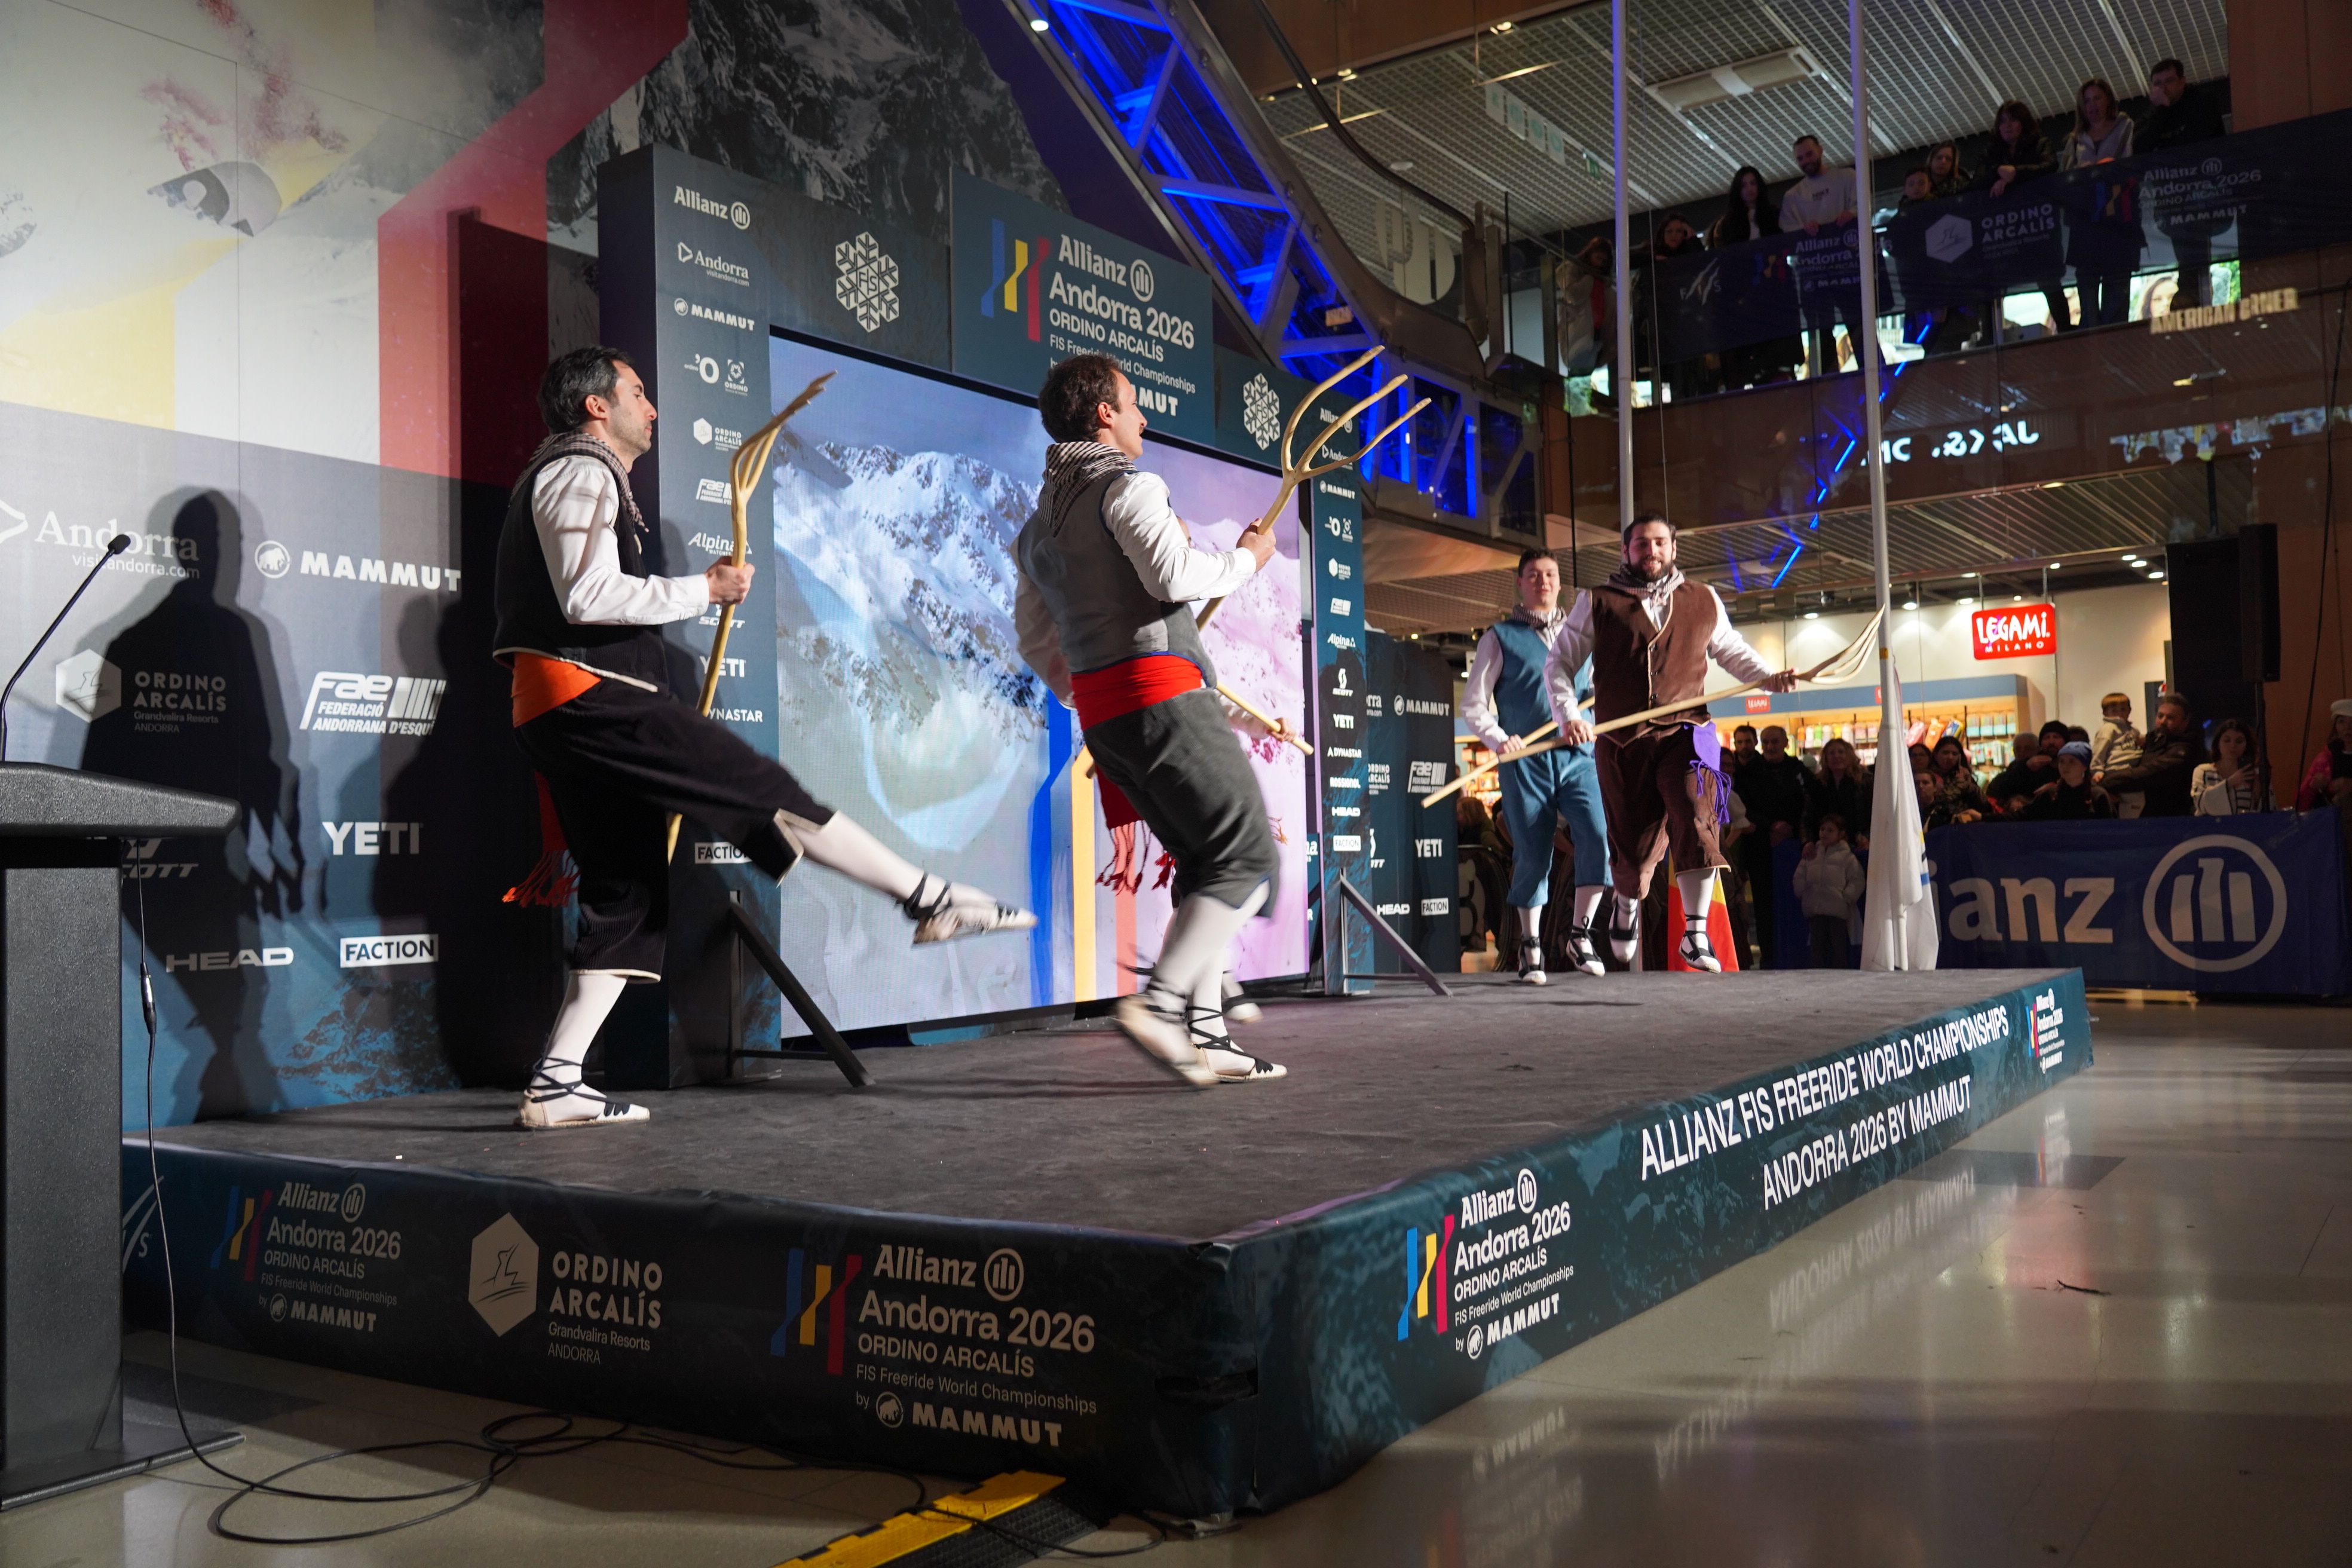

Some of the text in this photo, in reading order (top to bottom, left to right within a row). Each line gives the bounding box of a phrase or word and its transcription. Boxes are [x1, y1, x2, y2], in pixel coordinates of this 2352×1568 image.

[674, 186, 728, 220] Allianz
[1982, 204, 2053, 229] ORDINO
[694, 250, 749, 280] Andorra
[1058, 234, 1127, 287] Allianz
[691, 304, 755, 331] MAMMUT
[1049, 272, 1195, 350] Andorra 2026
[1049, 308, 1165, 362] ORDINO ARCALÍS
[1050, 334, 1065, 351] FIS
[1133, 362, 1196, 395] Championships
[1138, 386, 1178, 417] MUT
[715, 427, 742, 439] ORDINO
[1327, 483, 1355, 500] MAMMUT
[35, 511, 200, 561] Andorra
[72, 553, 200, 579] visiandorra.com
[301, 551, 461, 592] MAMMUT
[698, 616, 746, 629] SCTT
[1984, 641, 2044, 653] MILANO
[134, 670, 226, 693] ORDINO
[133, 691, 226, 712] ARCALÍS
[318, 701, 384, 718] FEDERACIÓ
[709, 708, 764, 723] YNASTAR
[1405, 699, 1450, 716] MAMMUT
[134, 722, 180, 733] ANDORRA
[312, 719, 386, 735] ANDORRANA
[1333, 714, 1354, 729] YETI
[1334, 747, 1362, 758] DYNASTAR
[1330, 777, 1361, 789] ROSSIGNOL
[1332, 807, 1361, 817] HEAD
[323, 822, 423, 856] YETI
[697, 845, 743, 859] FACTIO
[1335, 839, 1359, 848] FACTION
[1415, 838, 1443, 858] YETI
[1376, 904, 1410, 915] HEAD
[1423, 902, 1447, 913] FACTION
[166, 947, 295, 973] HEAD
[345, 939, 435, 961] FACTION
[1642, 1004, 2010, 1181] ALLIANZ FIS FREERIDE WORLD CHAMPIONSHIPS
[1763, 1075, 1971, 1211] ANDORRA 2026 BY MAMMUT
[277, 1181, 341, 1213] Allianz
[1461, 1187, 1516, 1229] Allianz
[267, 1216, 402, 1260] Andorra 2026
[1454, 1200, 1571, 1276] Andorra 2026
[264, 1250, 366, 1279] ORDINO ARCALÍS
[553, 1251, 663, 1291] ORDINO
[873, 1244, 977, 1287] Allianz
[1454, 1245, 1548, 1301] ORDINO ARCALÍS
[259, 1293, 268, 1309] by
[261, 1272, 397, 1307] FIS Freeride World Championships
[1455, 1264, 1574, 1327] FIS Freeride World Championships
[290, 1300, 377, 1332] MAMMUT
[549, 1286, 662, 1330] ARCALÍS
[859, 1289, 1095, 1353] Andorra 2026
[1487, 1292, 1560, 1346] MAMMUT
[549, 1321, 651, 1352] Grandvalira Resorts
[1456, 1337, 1464, 1353] by
[547, 1341, 601, 1365] ANDORRA
[858, 1333, 1035, 1378] ORDINO ARCALÍS
[856, 1363, 1097, 1416] FIS Freeride World Championships
[856, 1391, 870, 1409] by
[912, 1401, 1062, 1447] MAMMUT
